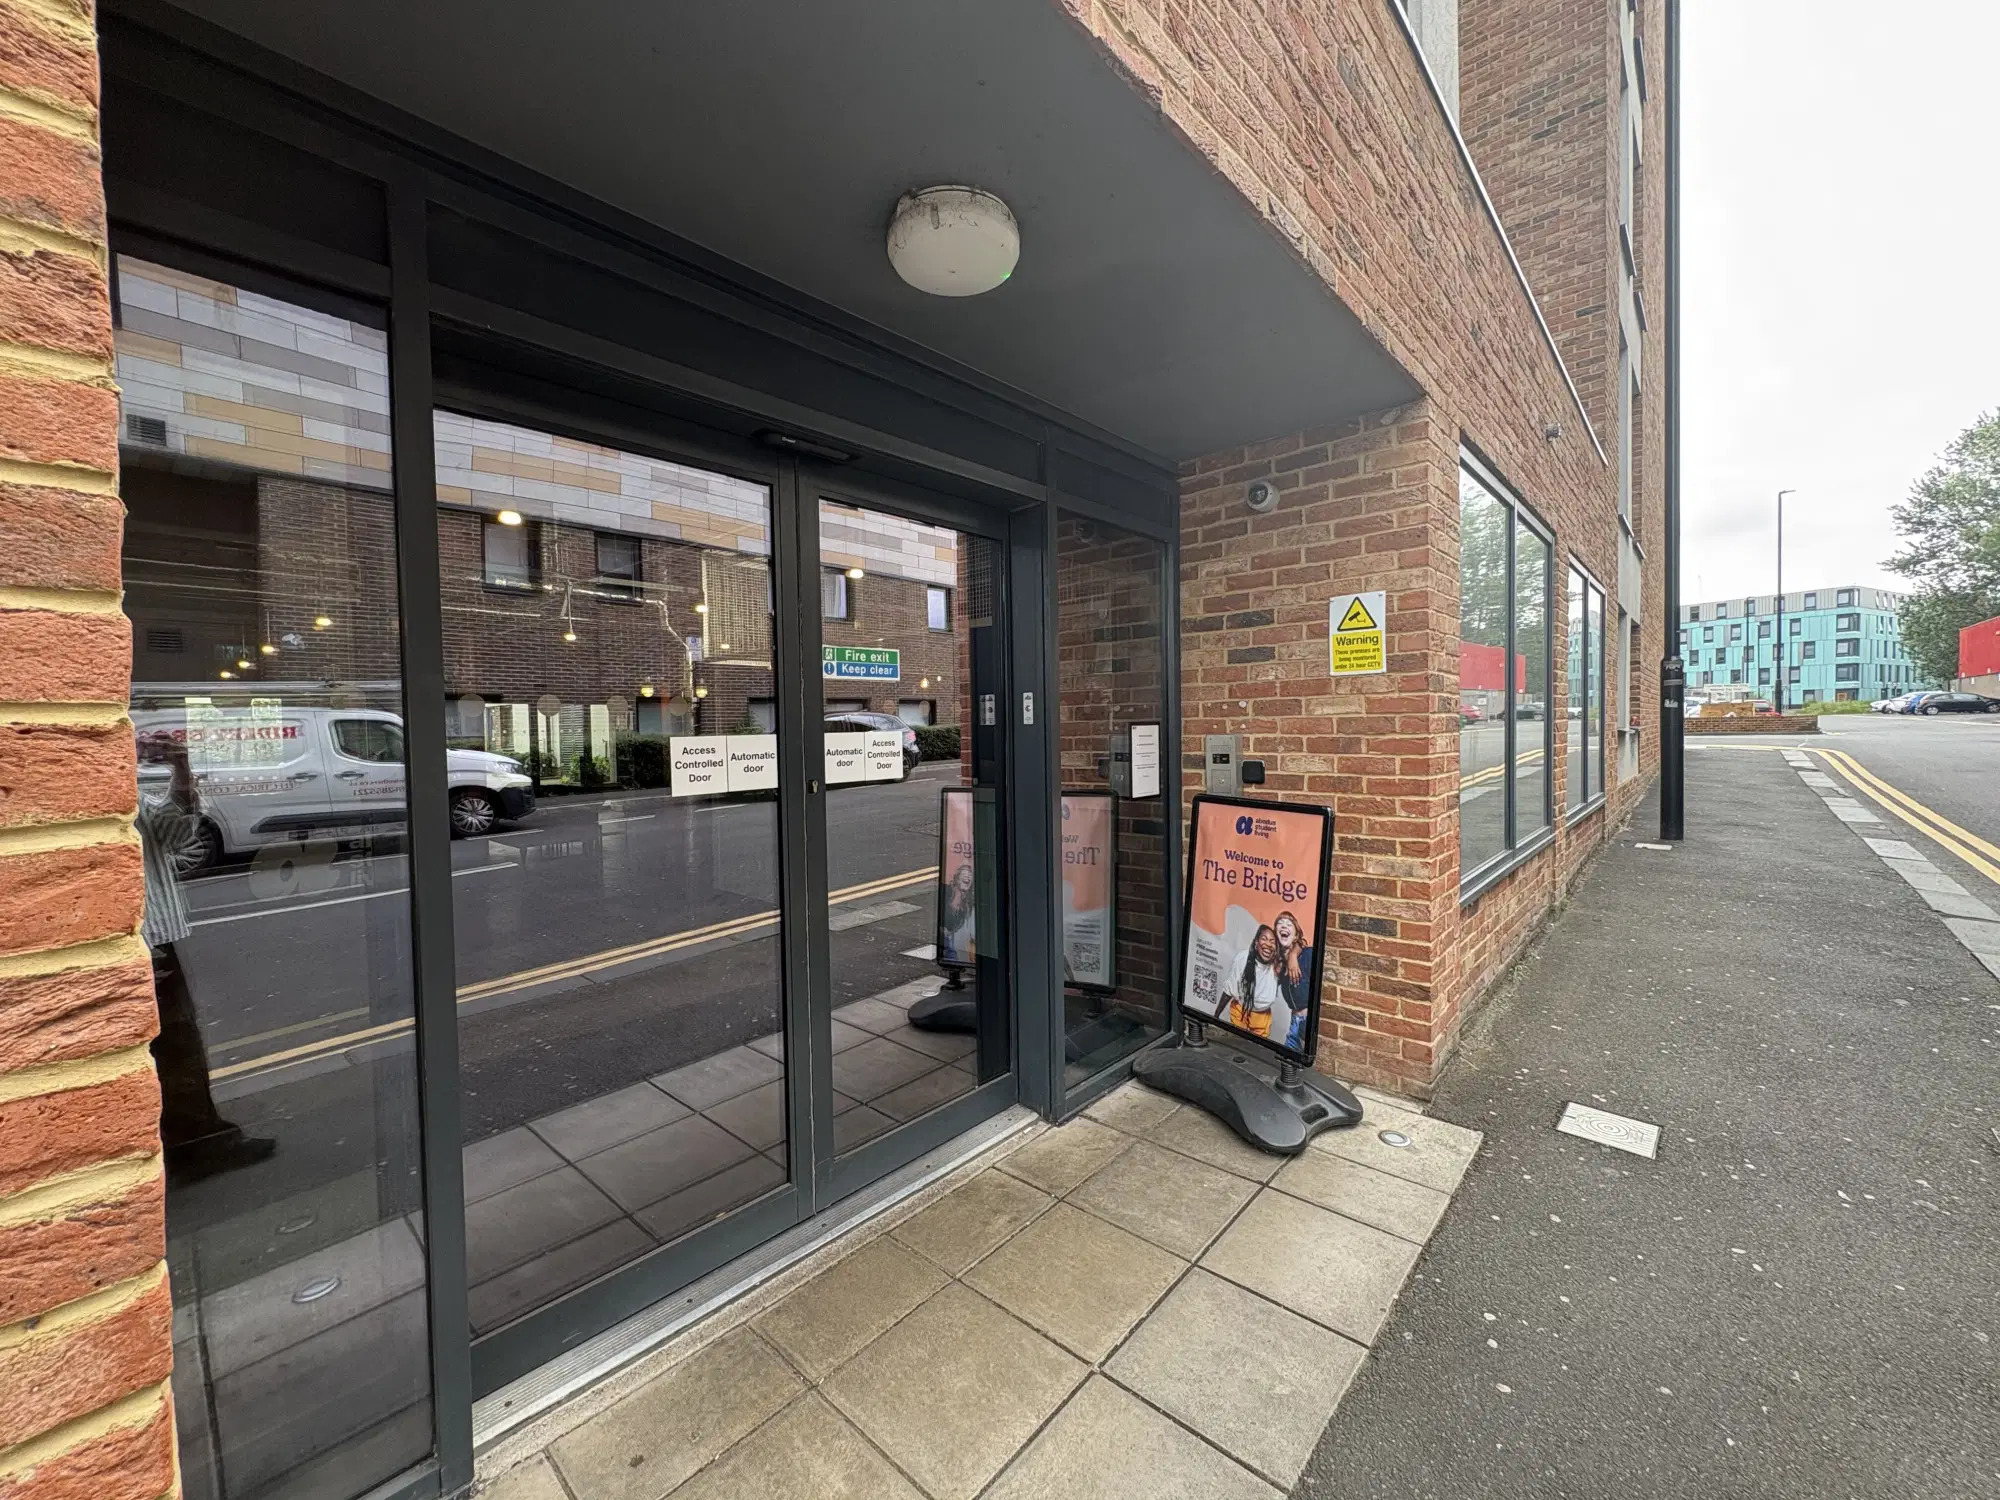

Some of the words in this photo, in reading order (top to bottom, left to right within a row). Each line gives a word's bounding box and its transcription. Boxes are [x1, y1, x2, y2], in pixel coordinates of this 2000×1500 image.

[1336, 634, 1379, 646] Warning
[845, 650, 866, 661] Fire
[870, 652, 889, 662] exit
[842, 664, 866, 675] Keep
[870, 665, 893, 675] clear
[682, 747, 716, 755] Access
[730, 751, 776, 761] Automatic
[826, 748, 863, 756] Automatic
[867, 750, 901, 759] Controlled
[674, 759, 724, 770] Controlled
[743, 764, 764, 773] door
[688, 774, 712, 783] Door
[1254, 830, 1269, 839] living
[1224, 850, 1269, 867] Welcome
[1272, 859, 1284, 870] to
[1203, 859, 1237, 885] The
[1242, 867, 1307, 903] Bridge
